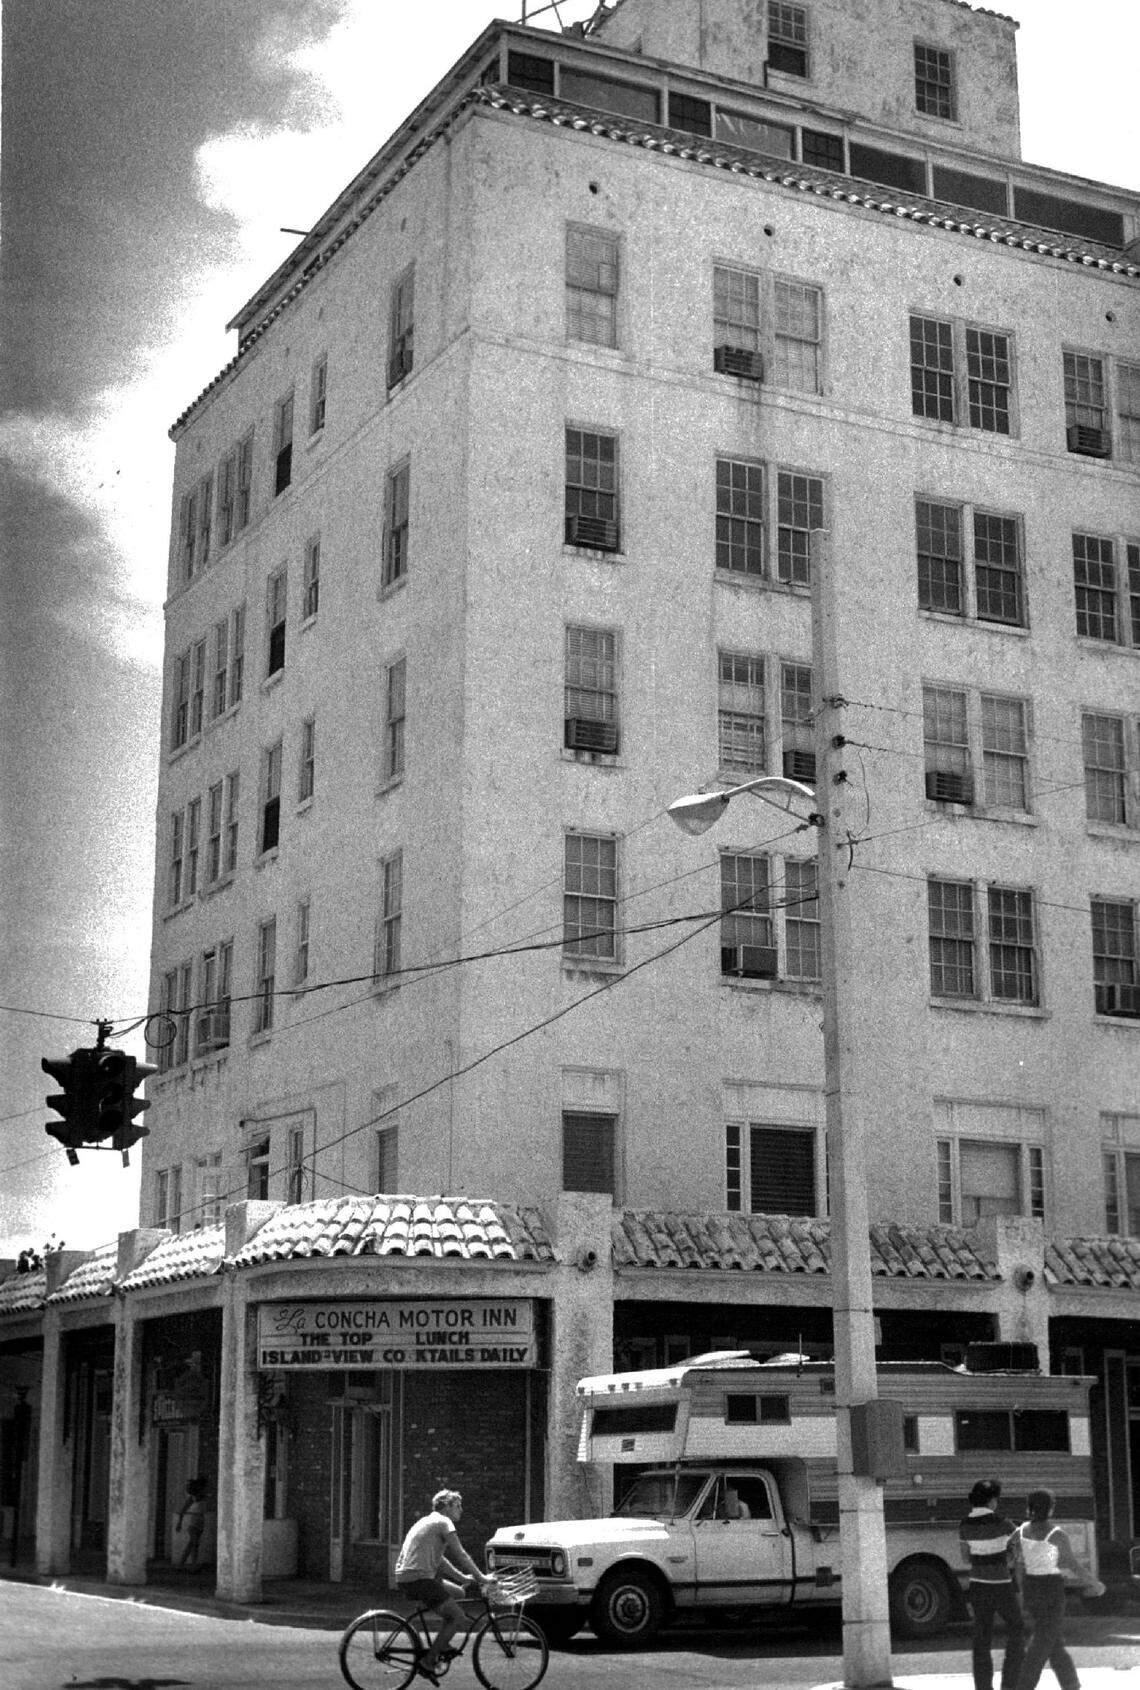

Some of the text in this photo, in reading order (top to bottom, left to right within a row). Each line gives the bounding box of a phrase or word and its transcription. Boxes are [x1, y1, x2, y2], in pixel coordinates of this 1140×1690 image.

[273, 1308, 517, 1334] La CONCHA MOTOR INN
[300, 1331, 470, 1346] THE TOP LUNCH
[480, 1347, 528, 1362] DAILY
